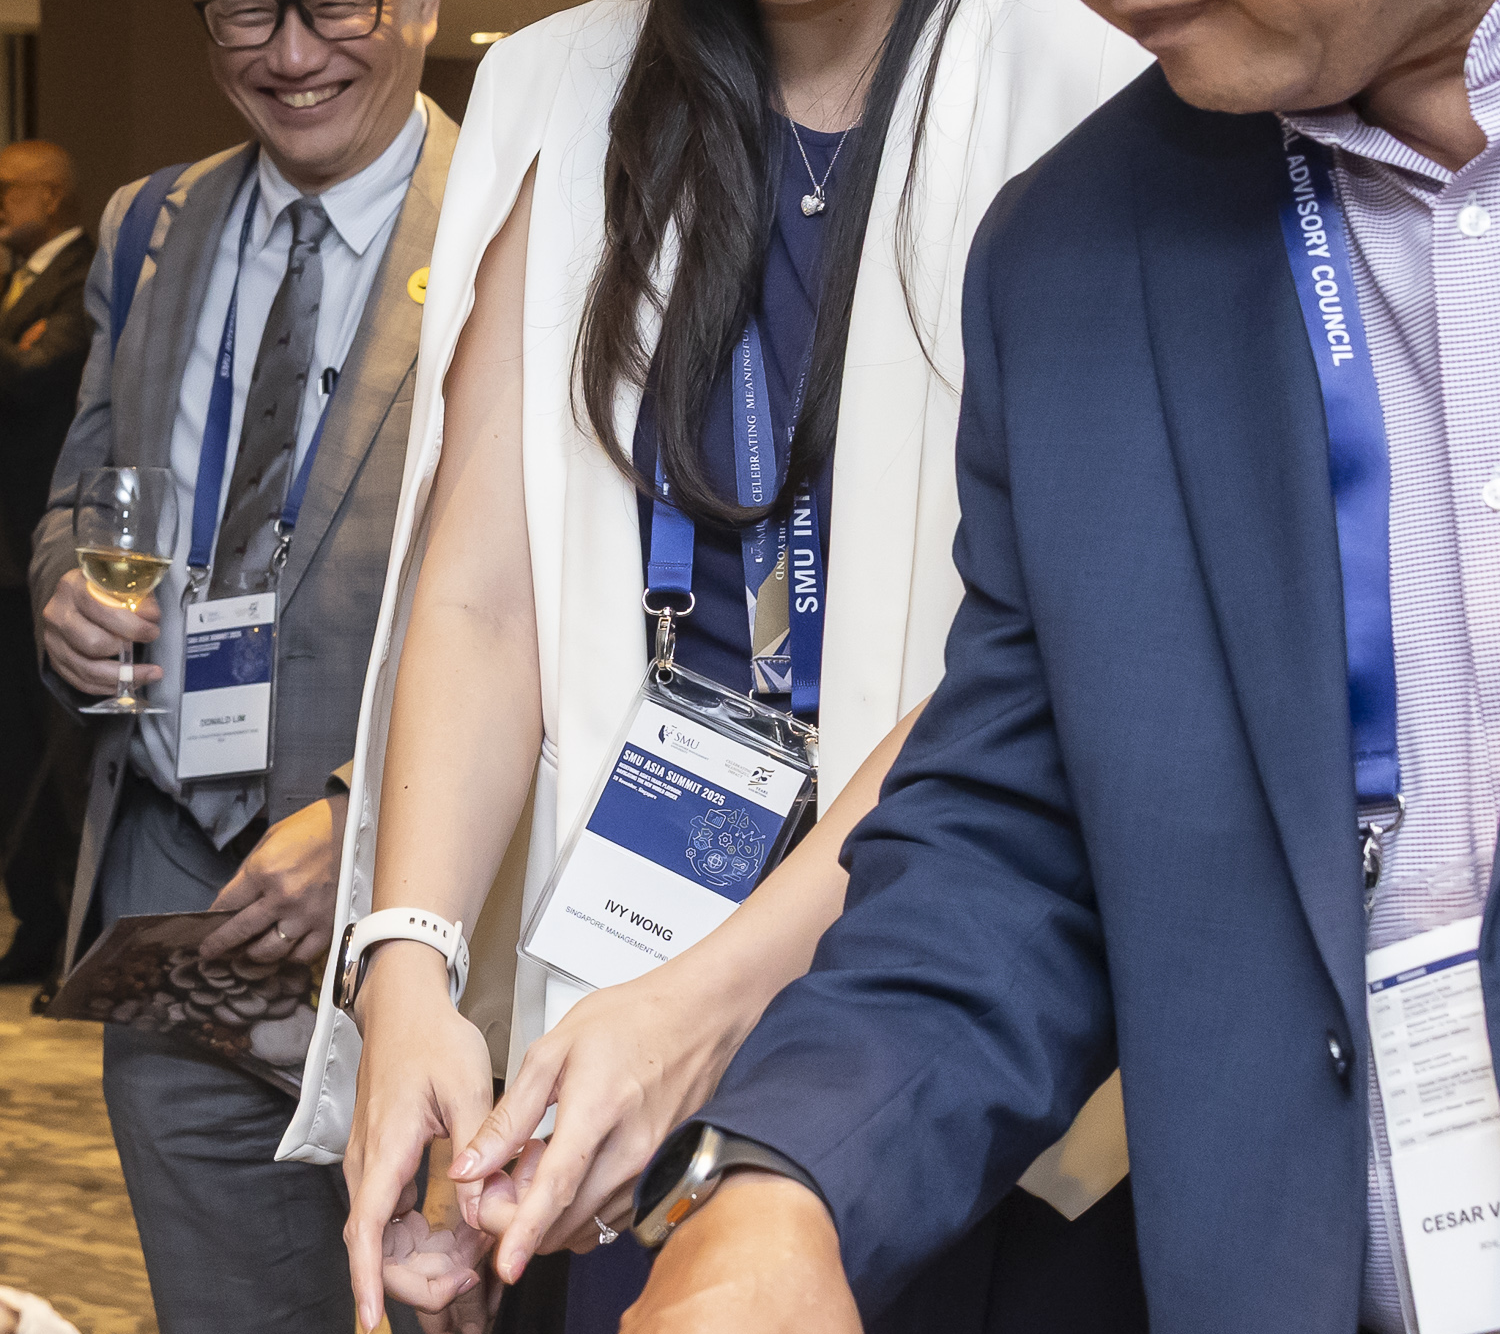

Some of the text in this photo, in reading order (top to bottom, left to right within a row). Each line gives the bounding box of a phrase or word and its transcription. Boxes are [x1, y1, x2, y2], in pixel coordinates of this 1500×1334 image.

[1286, 154, 1331, 258] ADVISORY
[1312, 265, 1354, 367] COUNCIL
[746, 415, 763, 503] CELEBRATING
[794, 548, 818, 613] SMU
[673, 732, 700, 750] SMU
[623, 750, 645, 766] SMU
[643, 759, 666, 778] ASIA
[666, 770, 702, 794] SUMMIT
[701, 787, 726, 806] 2025
[565, 906, 605, 930] SINGAPORE
[605, 926, 654, 955] MANAGEMENT
[605, 899, 673, 941] IVY WONG
[1422, 1206, 1484, 1235] CESAR
